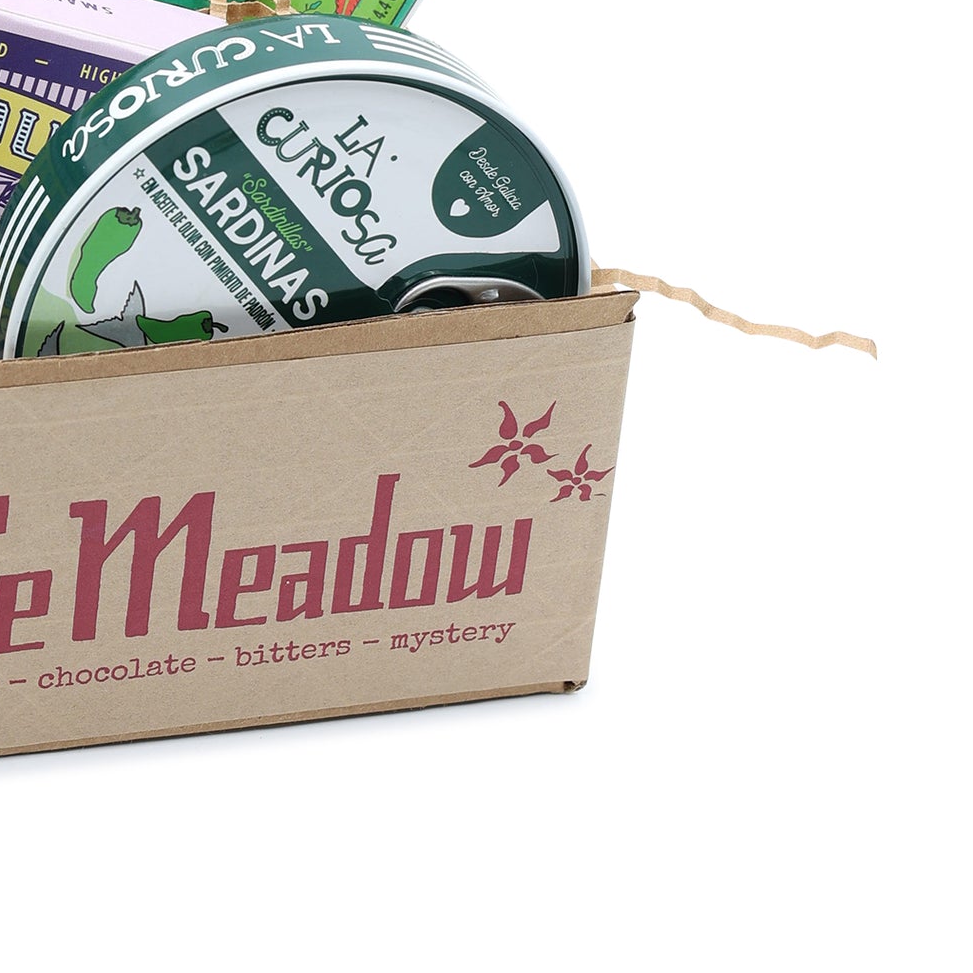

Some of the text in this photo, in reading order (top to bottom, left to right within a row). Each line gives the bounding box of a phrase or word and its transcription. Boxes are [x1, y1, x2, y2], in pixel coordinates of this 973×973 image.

[372, 0, 392, 19] 4.4
[62, 23, 342, 162] LA CURIOSA
[257, 107, 397, 266] CURIOSA
[334, 115, 386, 178] LA
[459, 169, 500, 218] con Amor
[468, 147, 524, 211] Desde Galicia
[140, 177, 276, 331] EN ACEITE DE OLIVA CON PIMIENTO DE PADRÓN
[173, 146, 328, 320] SARDINAS
[69, 473, 533, 642] Meadow
[37, 652, 197, 691] chocolate
[235, 634, 351, 668] bitters
[390, 619, 517, 653] mystery
